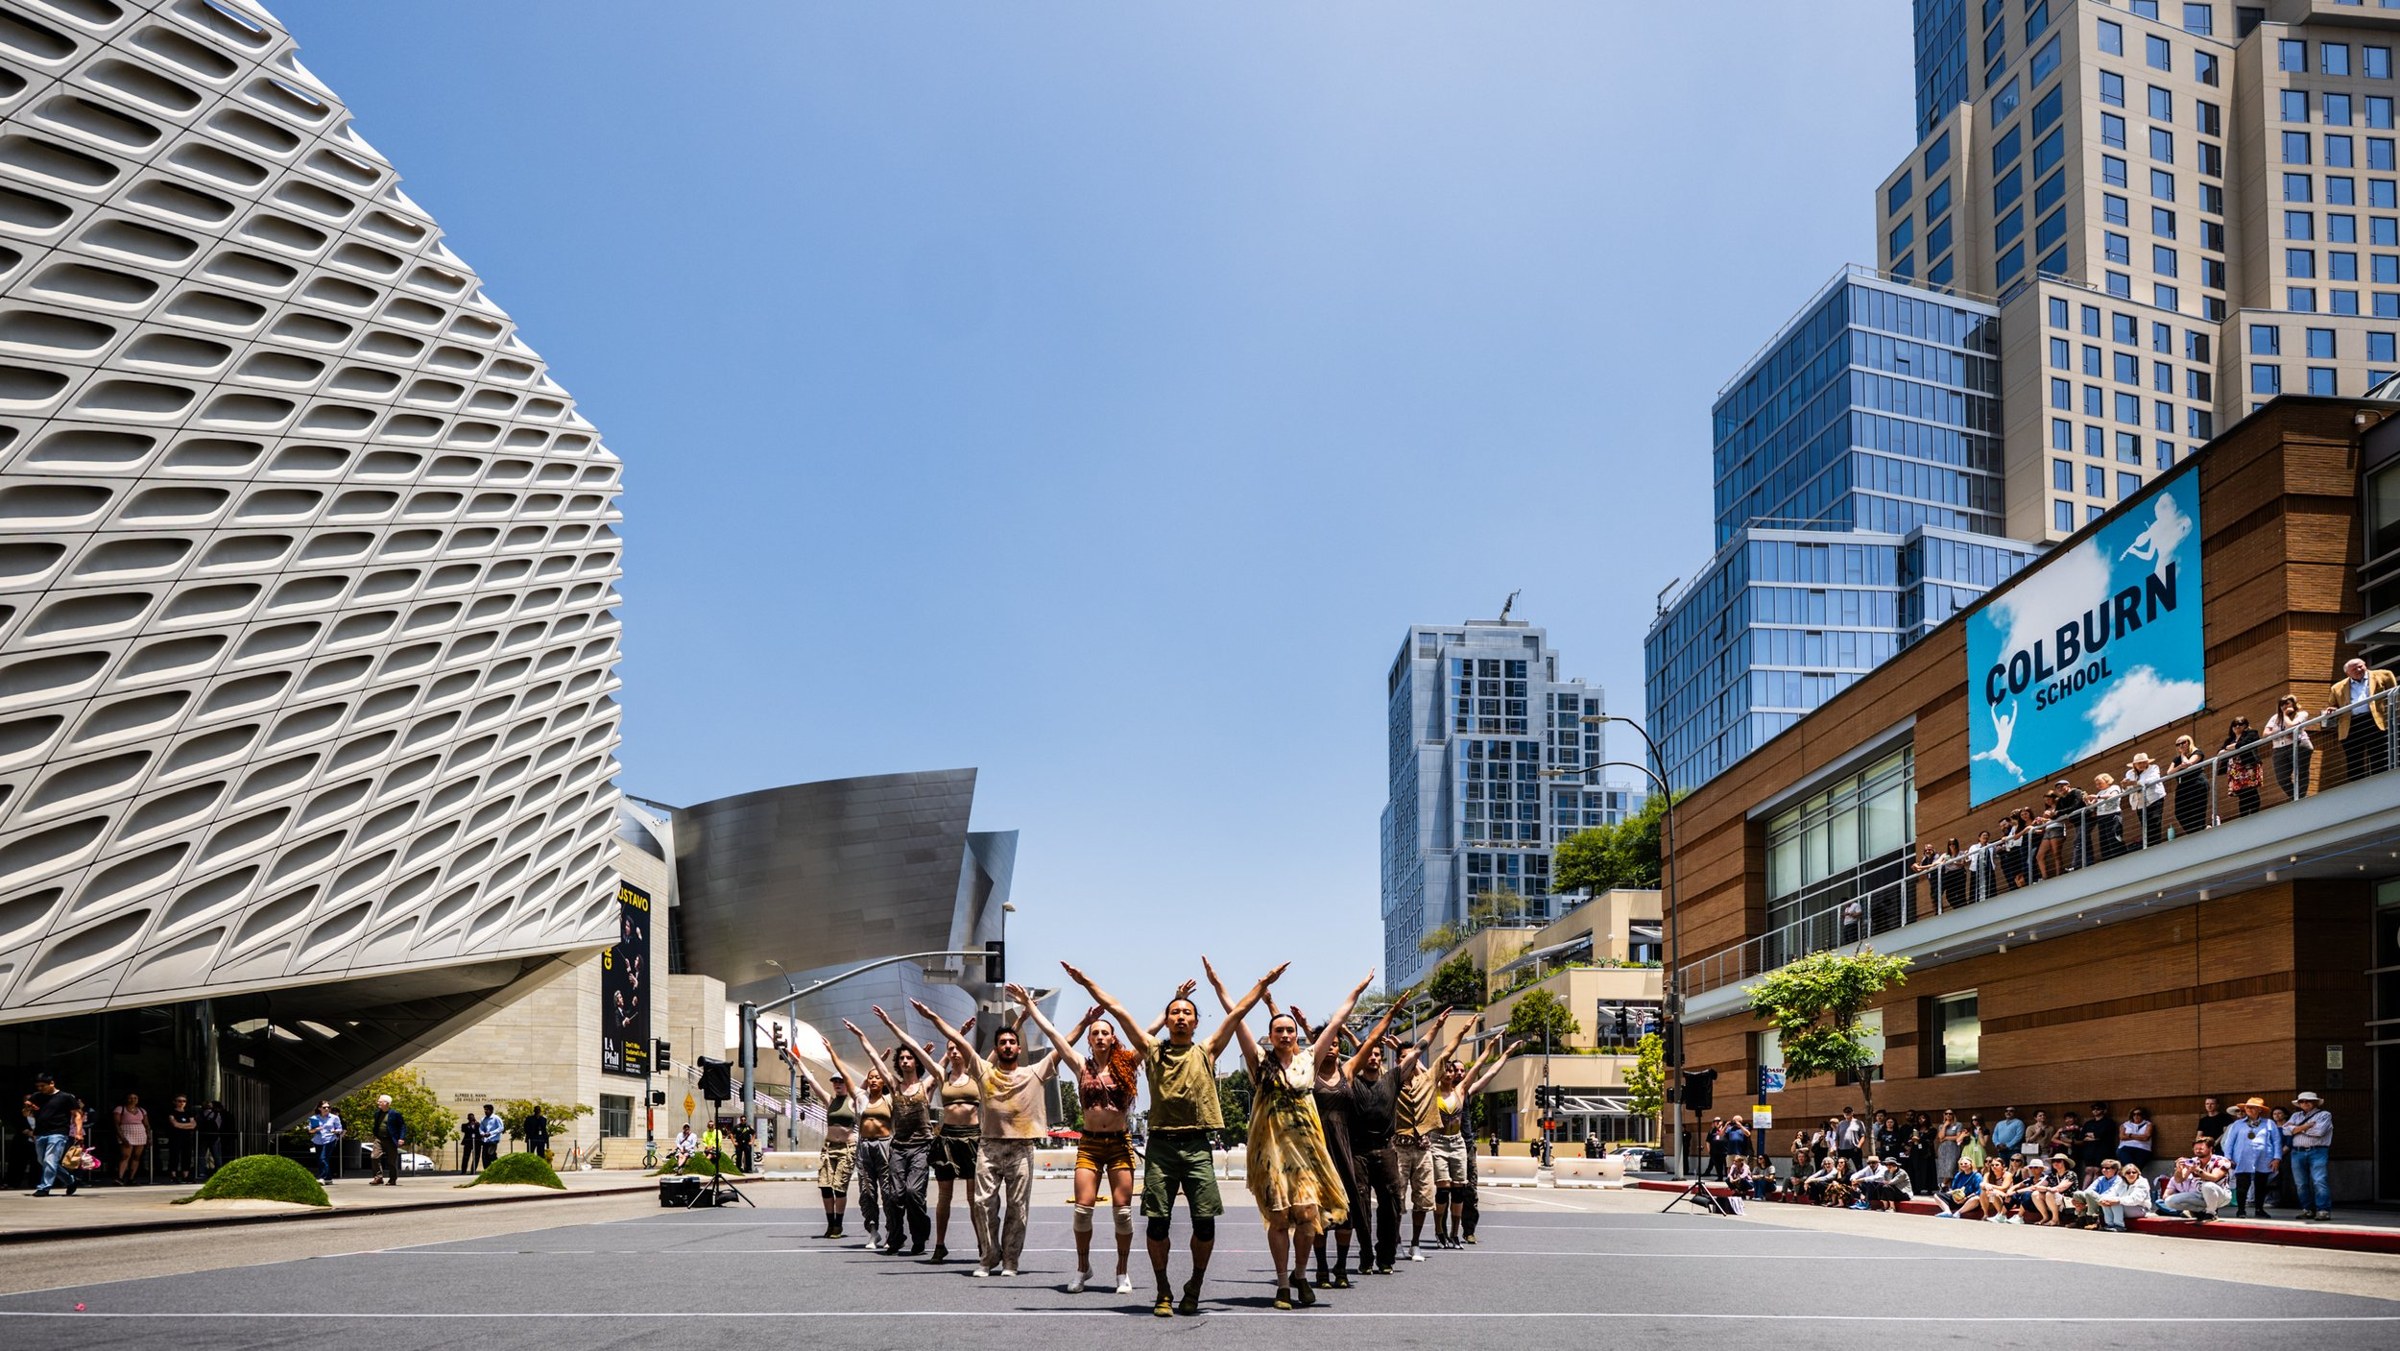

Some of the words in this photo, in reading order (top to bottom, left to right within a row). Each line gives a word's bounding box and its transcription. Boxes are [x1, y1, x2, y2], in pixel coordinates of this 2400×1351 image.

[1985, 562, 2178, 707] COLBURN
[2036, 656, 2113, 711] SCHOOL
[618, 887, 649, 912] USTAVO
[604, 1037, 614, 1051] LA
[604, 1051, 619, 1065] Phil
